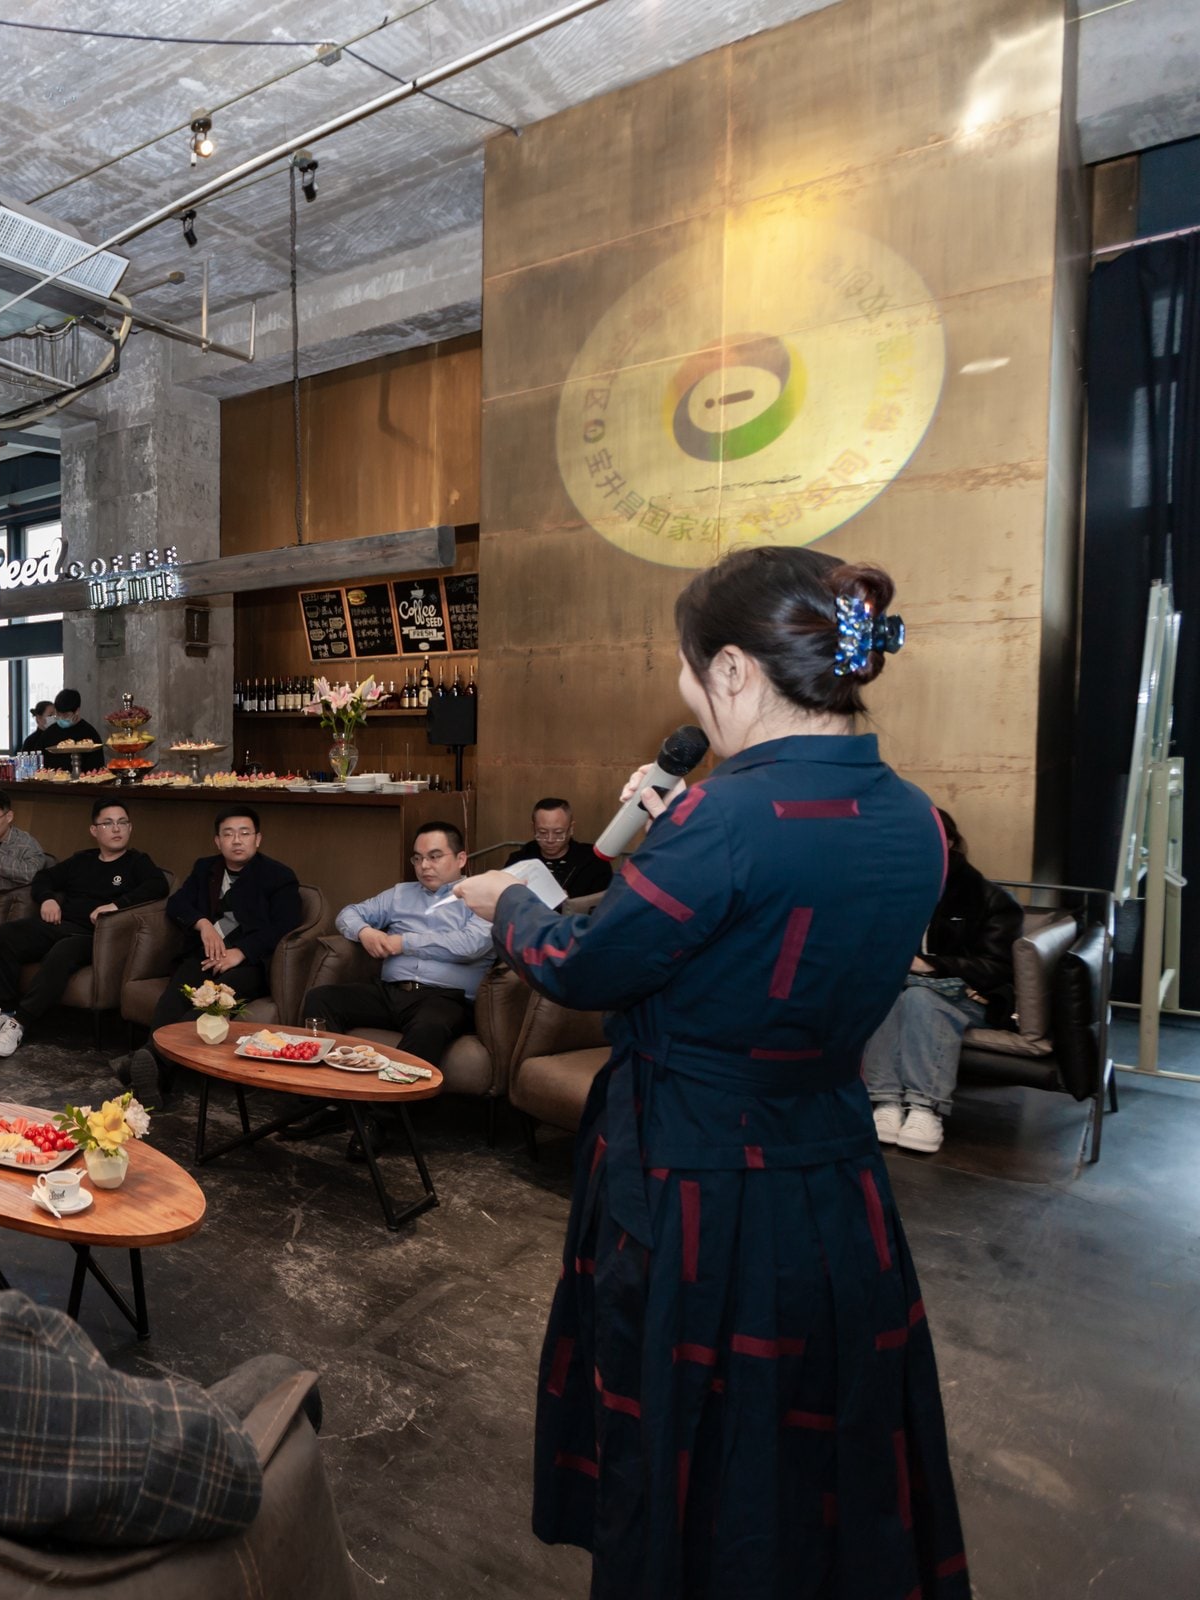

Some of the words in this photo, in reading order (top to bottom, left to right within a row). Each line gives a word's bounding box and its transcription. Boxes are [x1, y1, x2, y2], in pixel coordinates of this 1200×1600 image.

[399, 599, 436, 625] Coffee
[426, 617, 443, 628] SEED
[412, 630, 435, 638] FRESH
